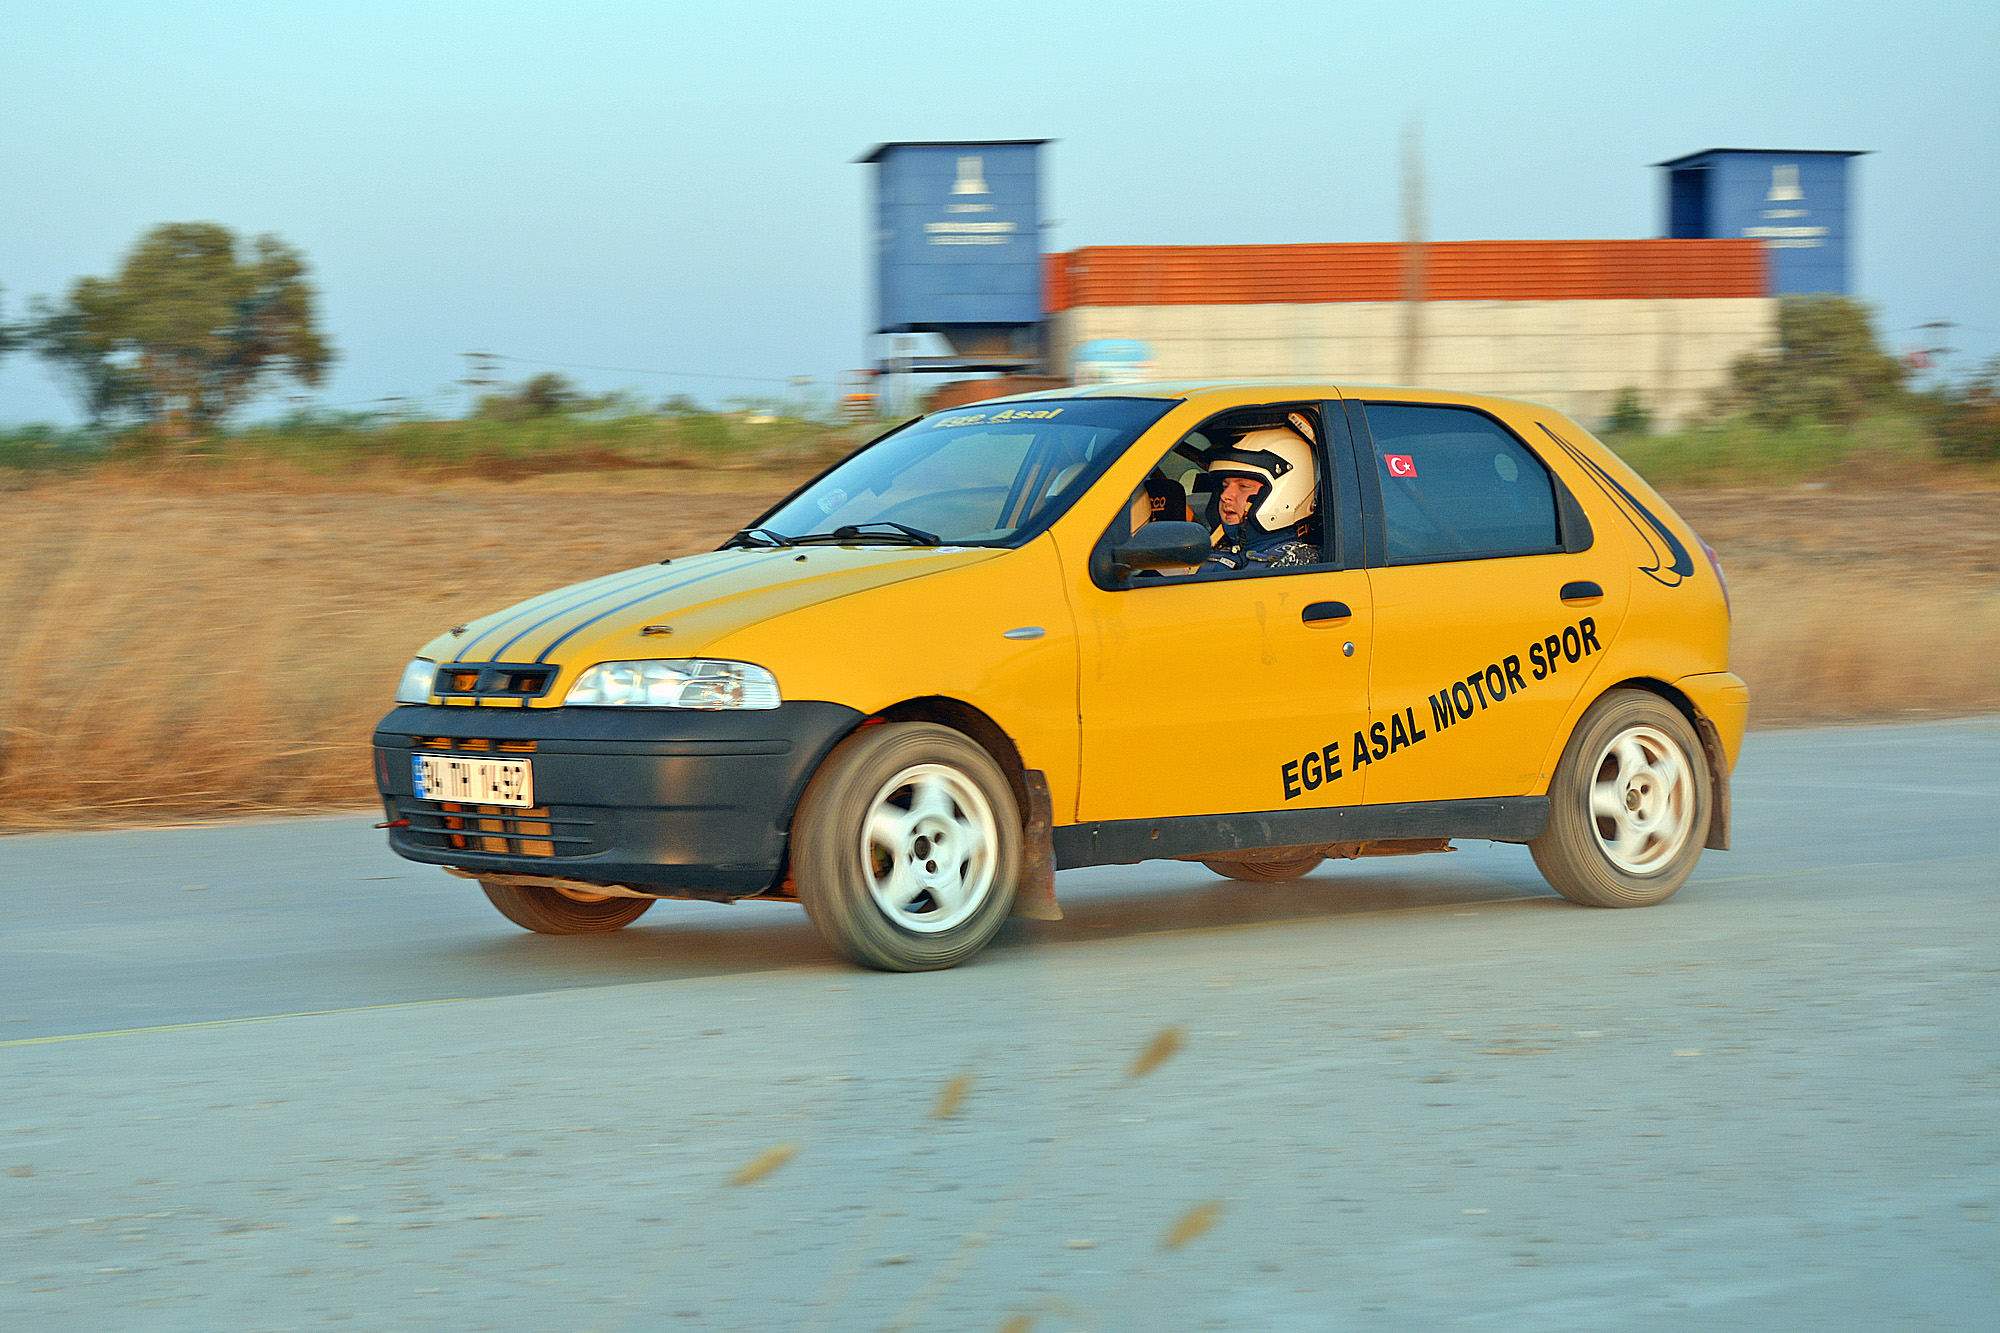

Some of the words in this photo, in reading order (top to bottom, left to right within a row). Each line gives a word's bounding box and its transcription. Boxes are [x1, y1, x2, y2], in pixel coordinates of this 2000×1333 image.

[989, 408, 1064, 420] Asal
[1281, 741, 1343, 801] EGE
[1352, 706, 1426, 772] ASAL
[1428, 654, 1527, 732] MOTOR
[1529, 616, 1602, 681] SPOR
